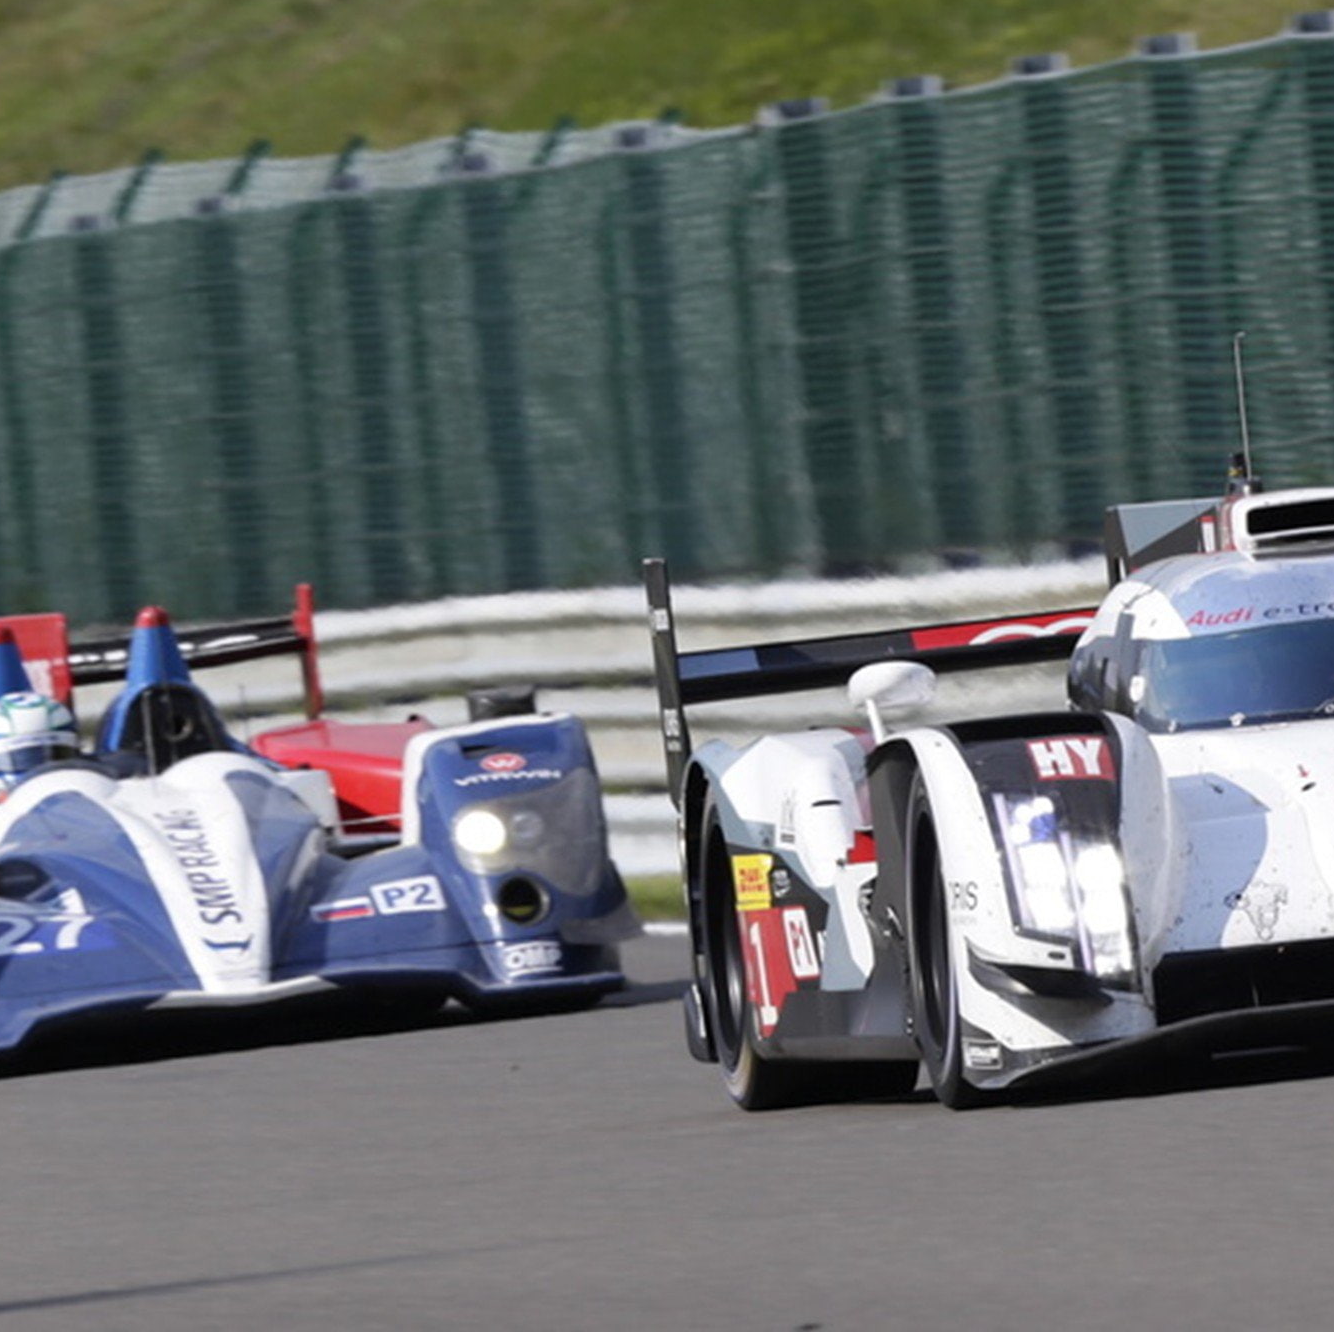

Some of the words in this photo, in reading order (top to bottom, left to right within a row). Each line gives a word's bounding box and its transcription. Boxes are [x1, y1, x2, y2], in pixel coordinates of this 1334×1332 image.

[1186, 607, 1254, 626] Audi
[1028, 738, 1102, 777] HY
[185, 871, 242, 925] SMP
[380, 882, 436, 908] P2
[789, 920, 813, 966] P1
[749, 921, 779, 1026] 1
